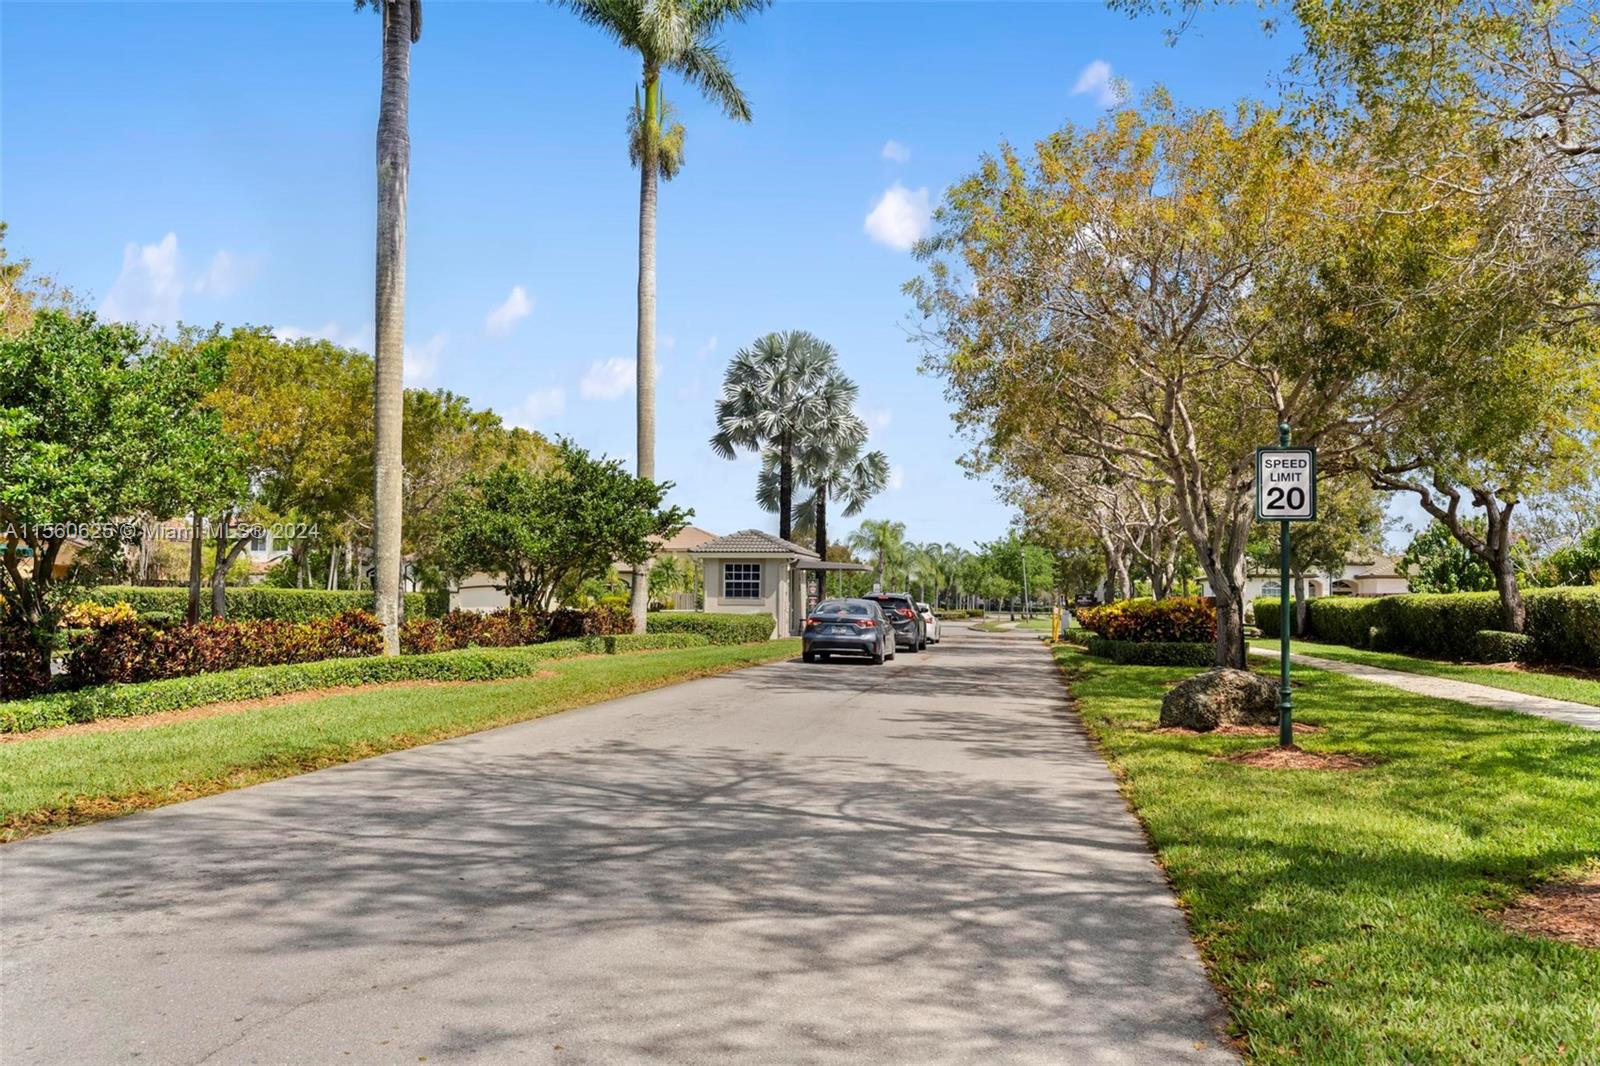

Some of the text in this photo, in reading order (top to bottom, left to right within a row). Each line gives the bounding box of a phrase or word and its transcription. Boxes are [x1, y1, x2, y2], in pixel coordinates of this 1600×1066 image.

[1265, 459, 1307, 468] SPEED
[1270, 472, 1302, 482] LIMIT
[1266, 487, 1305, 510] 20
